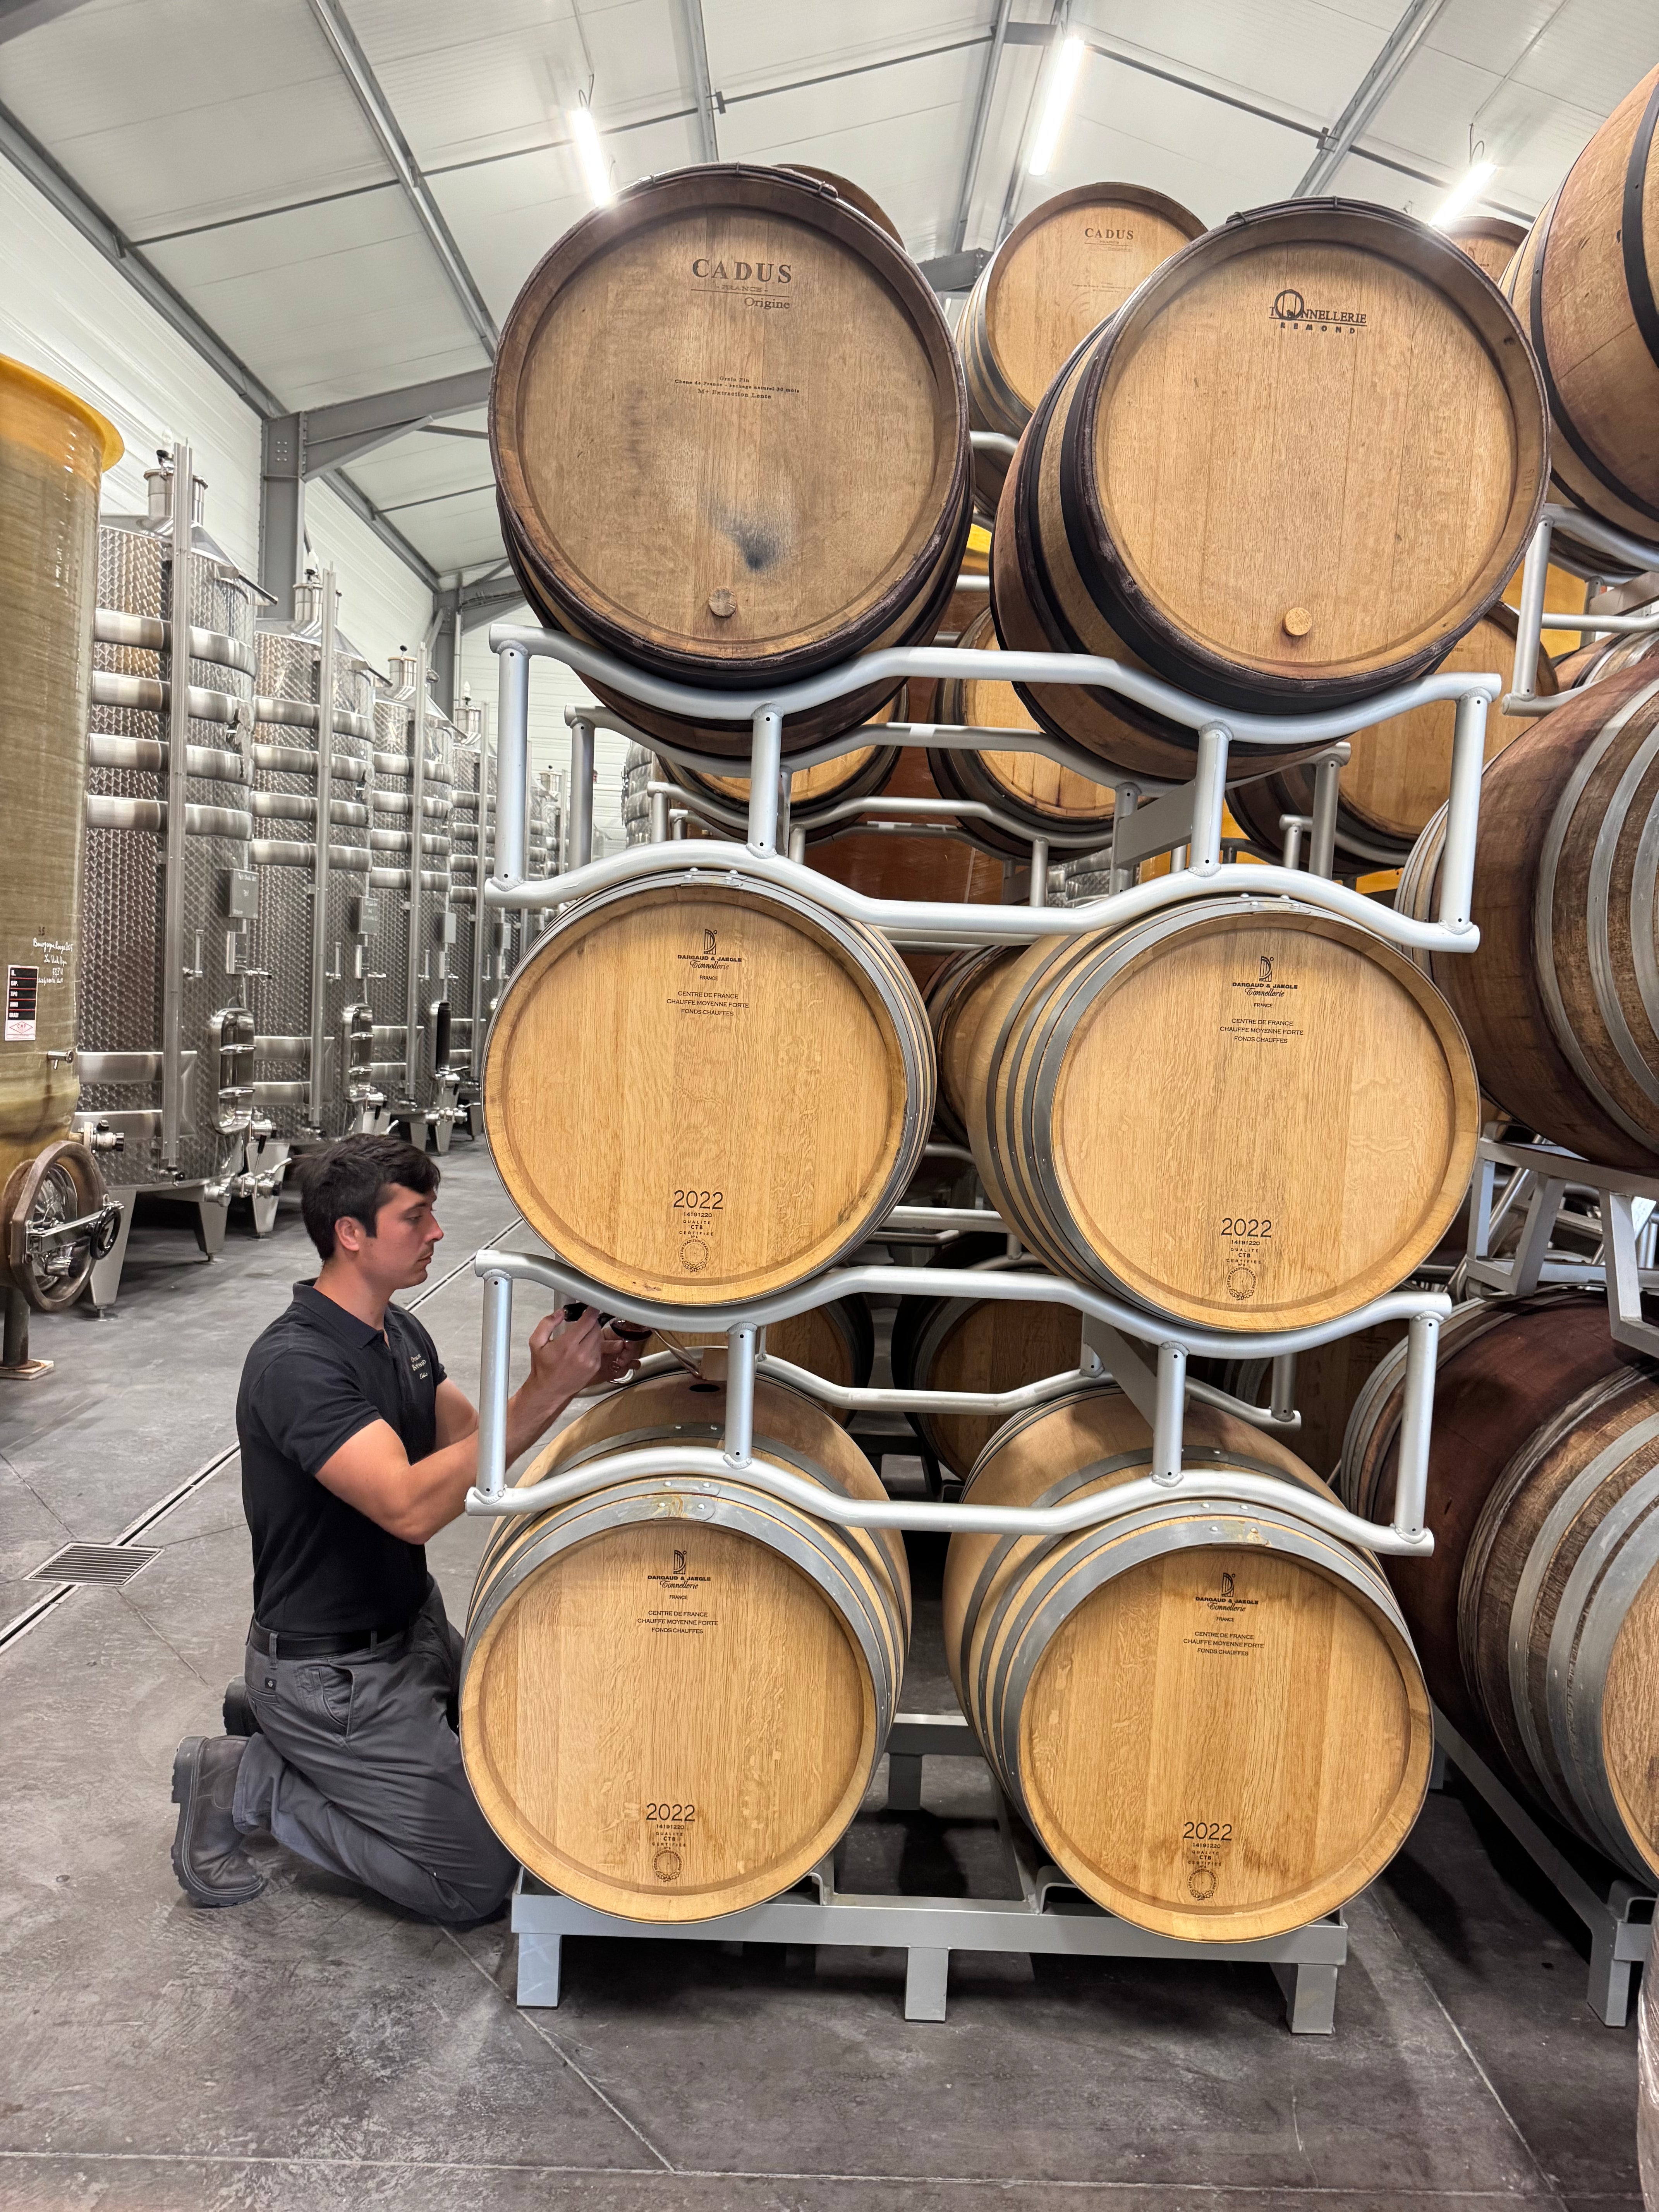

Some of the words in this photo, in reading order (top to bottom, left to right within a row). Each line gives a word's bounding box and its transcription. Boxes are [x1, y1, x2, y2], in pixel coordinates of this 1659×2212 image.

[1085, 228, 1134, 240] CADUS
[692, 258, 792, 284] CADUS
[744, 297, 790, 310] Origine
[1280, 322, 1355, 334] REMOND
[673, 1190, 723, 1210] 2022
[1221, 1218, 1272, 1238] 2022
[646, 1803, 695, 1822] 2022
[1183, 1822, 1232, 1841] 2022
